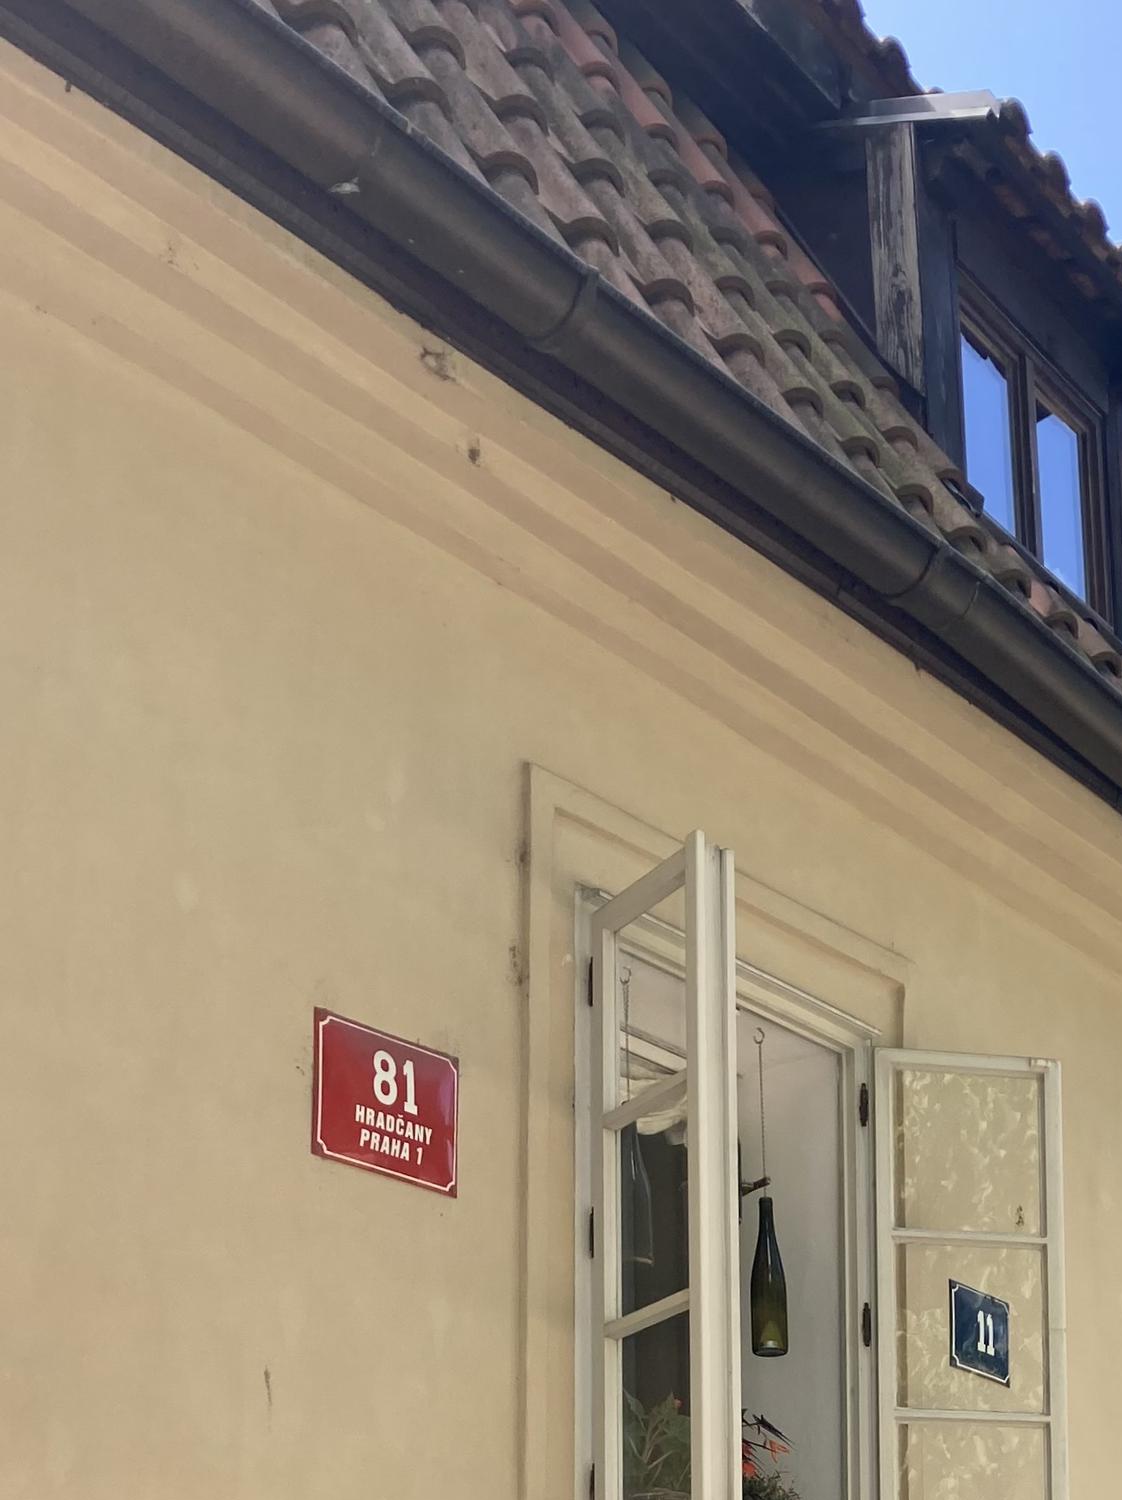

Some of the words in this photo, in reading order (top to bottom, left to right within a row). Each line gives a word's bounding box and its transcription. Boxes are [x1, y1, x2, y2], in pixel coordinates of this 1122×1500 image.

[373, 1050, 418, 1115] 81
[355, 1104, 432, 1145] HRADČANY
[360, 1129, 410, 1161] PRAHA
[416, 1147, 424, 1166] 1
[977, 1310, 995, 1356] 11
